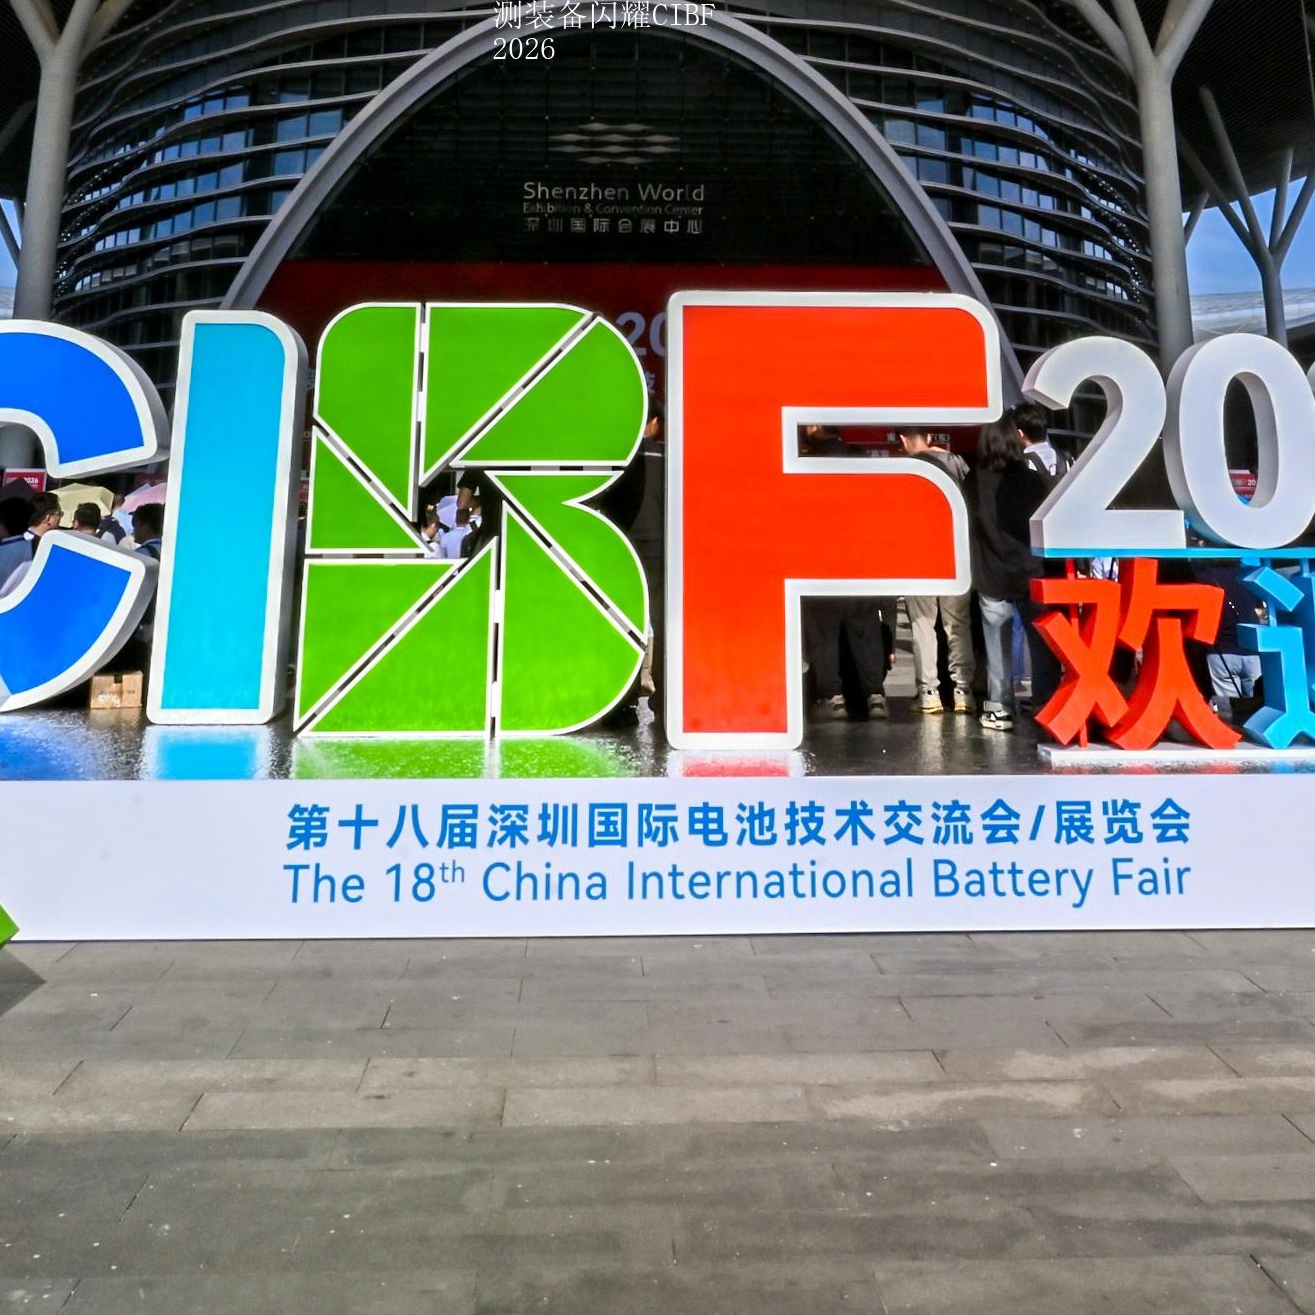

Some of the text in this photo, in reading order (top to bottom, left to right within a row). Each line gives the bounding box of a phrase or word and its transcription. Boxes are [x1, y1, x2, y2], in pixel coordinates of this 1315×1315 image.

[523, 182, 706, 202] Shenzhen World
[595, 203, 663, 215] Convention
[664, 203, 704, 216] Center
[523, 217, 703, 235] 深圳国际会展中心
[285, 797, 1191, 851] 第十八届深圳国际电池技术交流会/展览会
[283, 856, 1192, 909] The 18th China International Battery Fair
